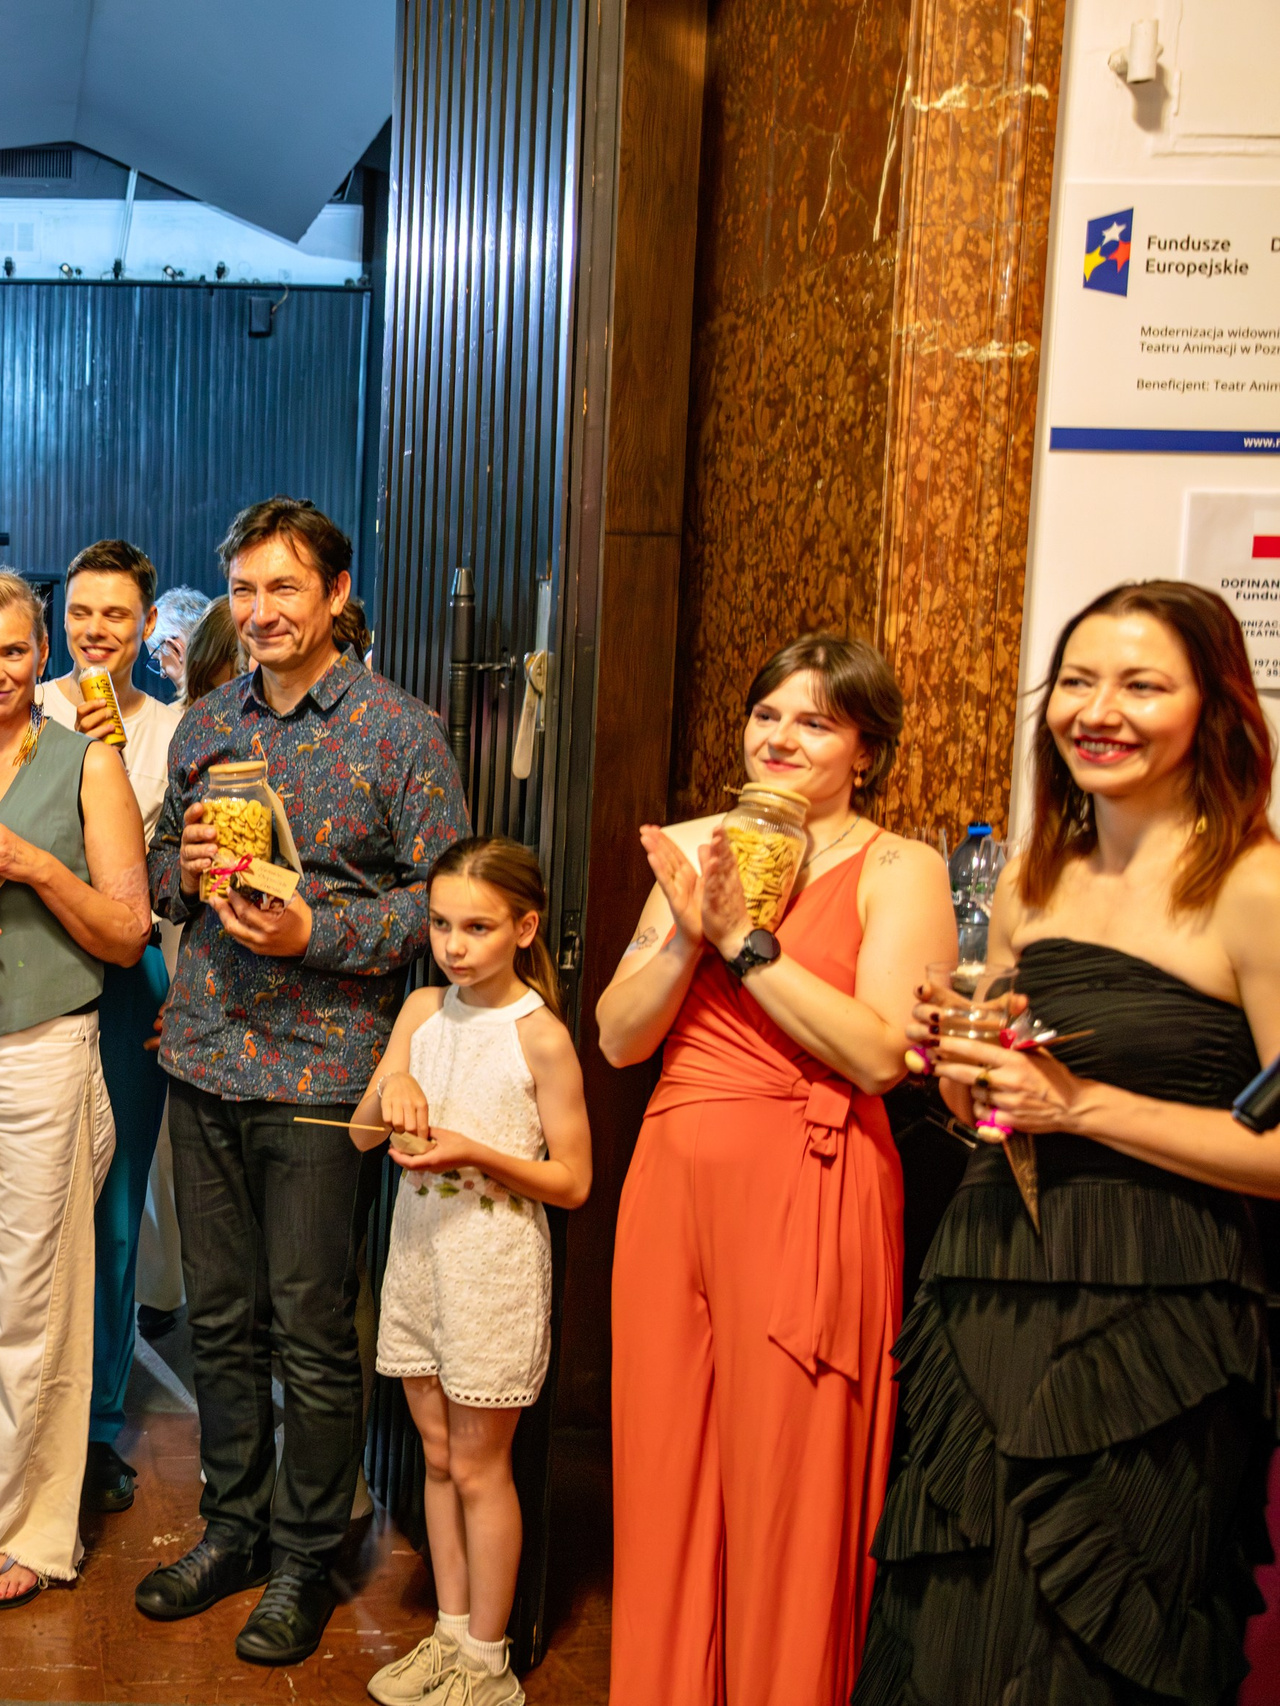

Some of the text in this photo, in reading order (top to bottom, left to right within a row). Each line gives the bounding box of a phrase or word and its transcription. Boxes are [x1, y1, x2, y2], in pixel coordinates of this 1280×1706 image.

[1146, 234, 1231, 252] Fundusze
[1144, 257, 1249, 278] Europejskie
[1139, 325, 1280, 340] Modernizacja widowni
[1139, 341, 1180, 354] Teatru
[1182, 342, 1237, 357] Animacji
[1240, 346, 1251, 354] w
[1136, 378, 1210, 393] Beneficjent:
[1214, 380, 1246, 392] Teatr
[1235, 590, 1280, 601] Fundu
